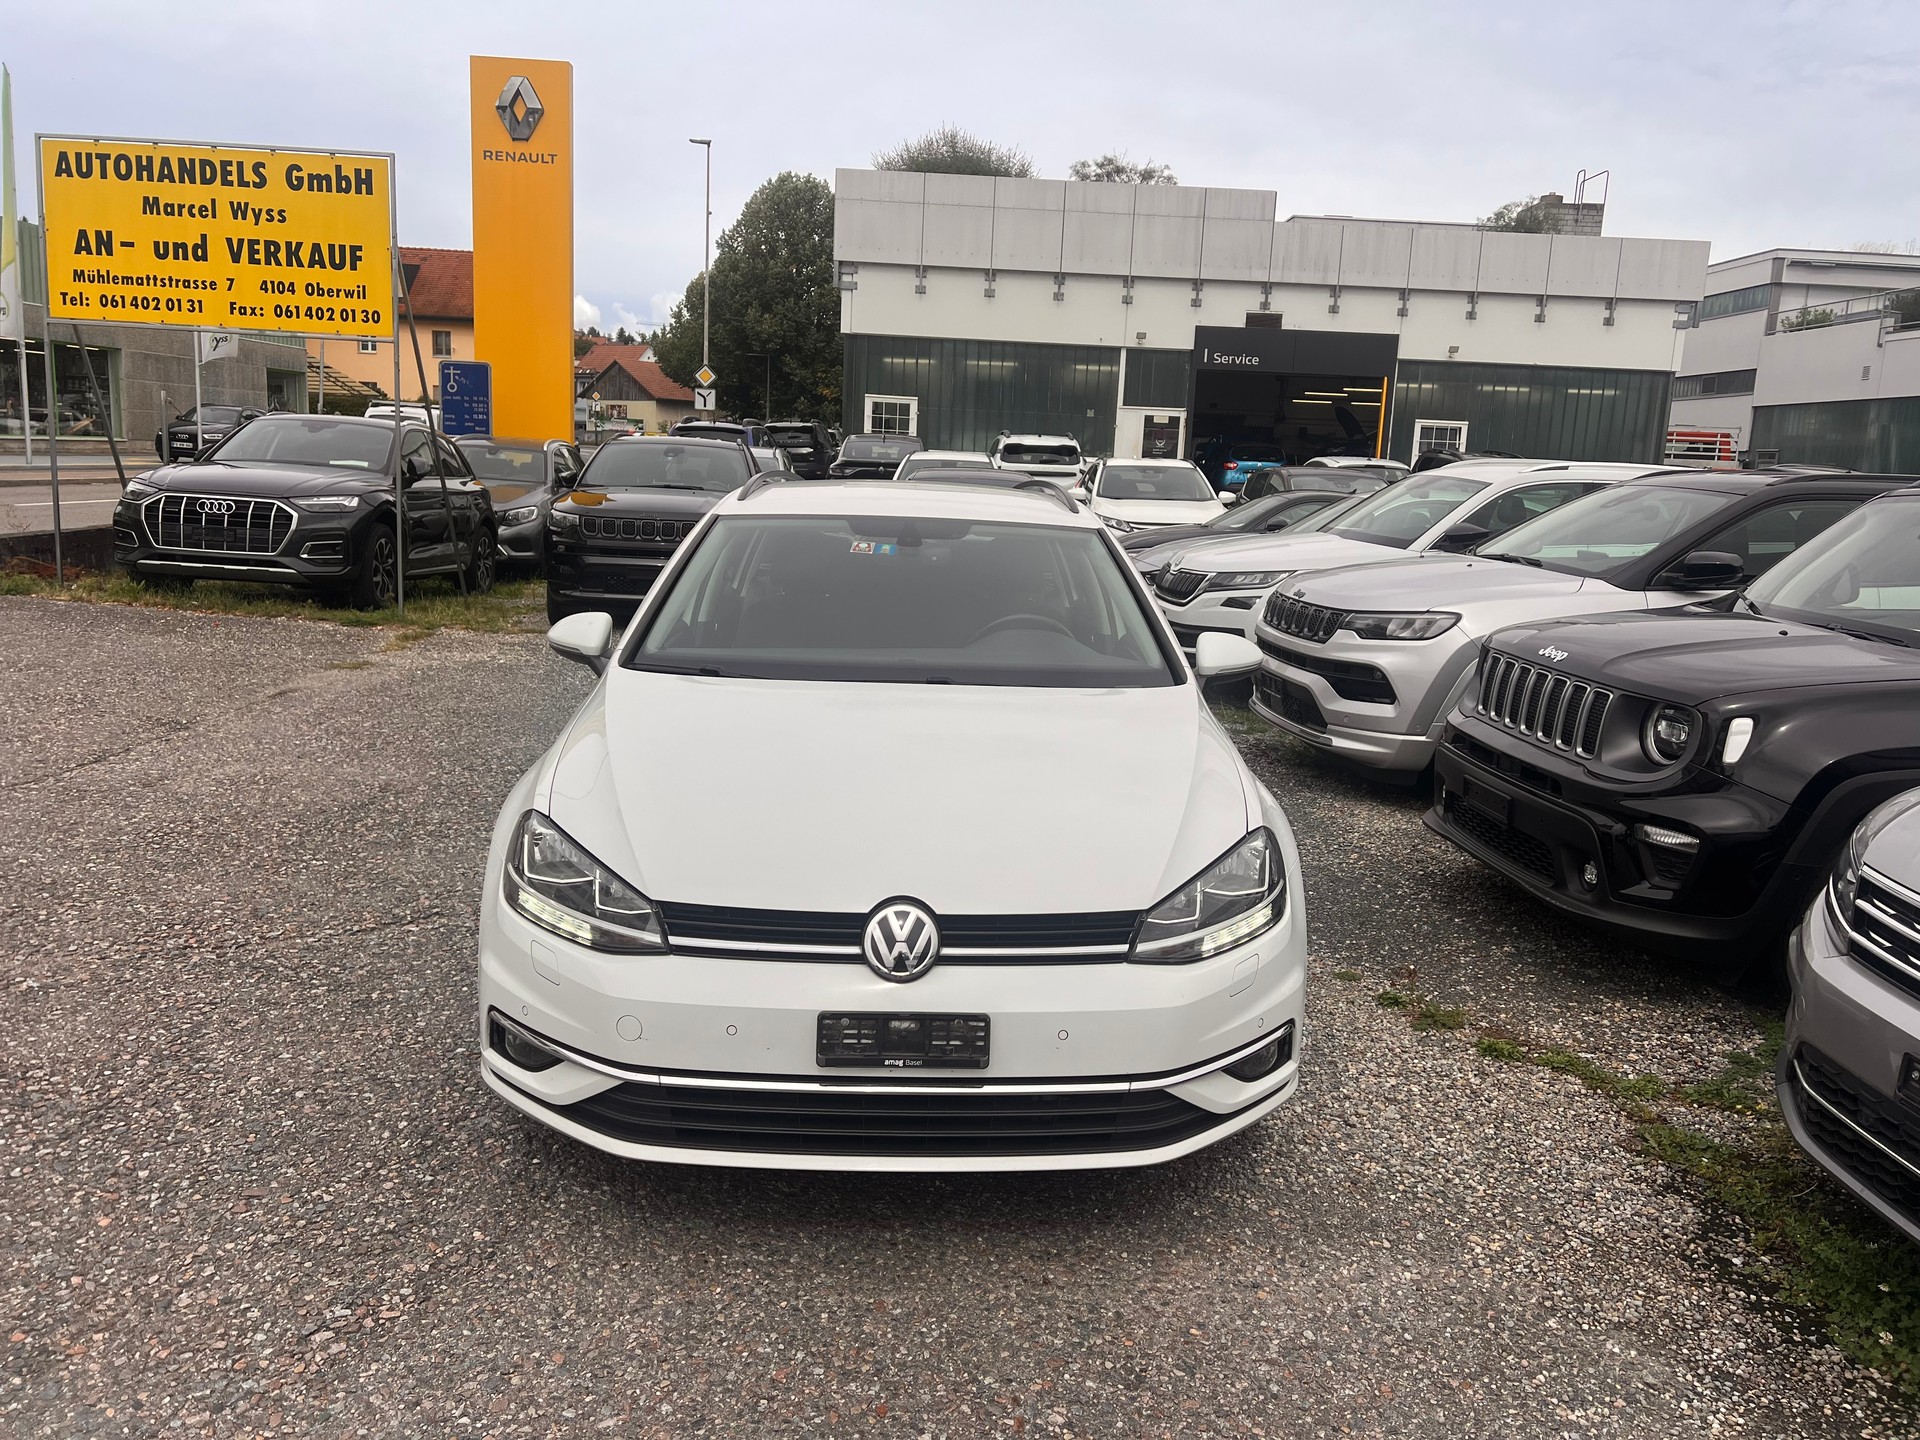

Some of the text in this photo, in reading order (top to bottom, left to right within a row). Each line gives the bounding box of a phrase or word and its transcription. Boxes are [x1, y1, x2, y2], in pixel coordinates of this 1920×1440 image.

[482, 149, 558, 165] RENAULT
[54, 150, 374, 196] AUTOHANDELS GmbH
[142, 195, 287, 226] Marcel Wyss
[152, 233, 209, 263] und
[224, 236, 363, 272] VERKAUF
[72, 268, 367, 300] Mühlemattstrasse 7 4104 Oberwil
[59, 291, 90, 308] Tel:
[229, 301, 265, 318] Fax:
[211, 335, 229, 351] yss
[1213, 352, 1260, 365] Service
[1538, 645, 1569, 663] Jeep
[884, 1059, 904, 1067] amag
